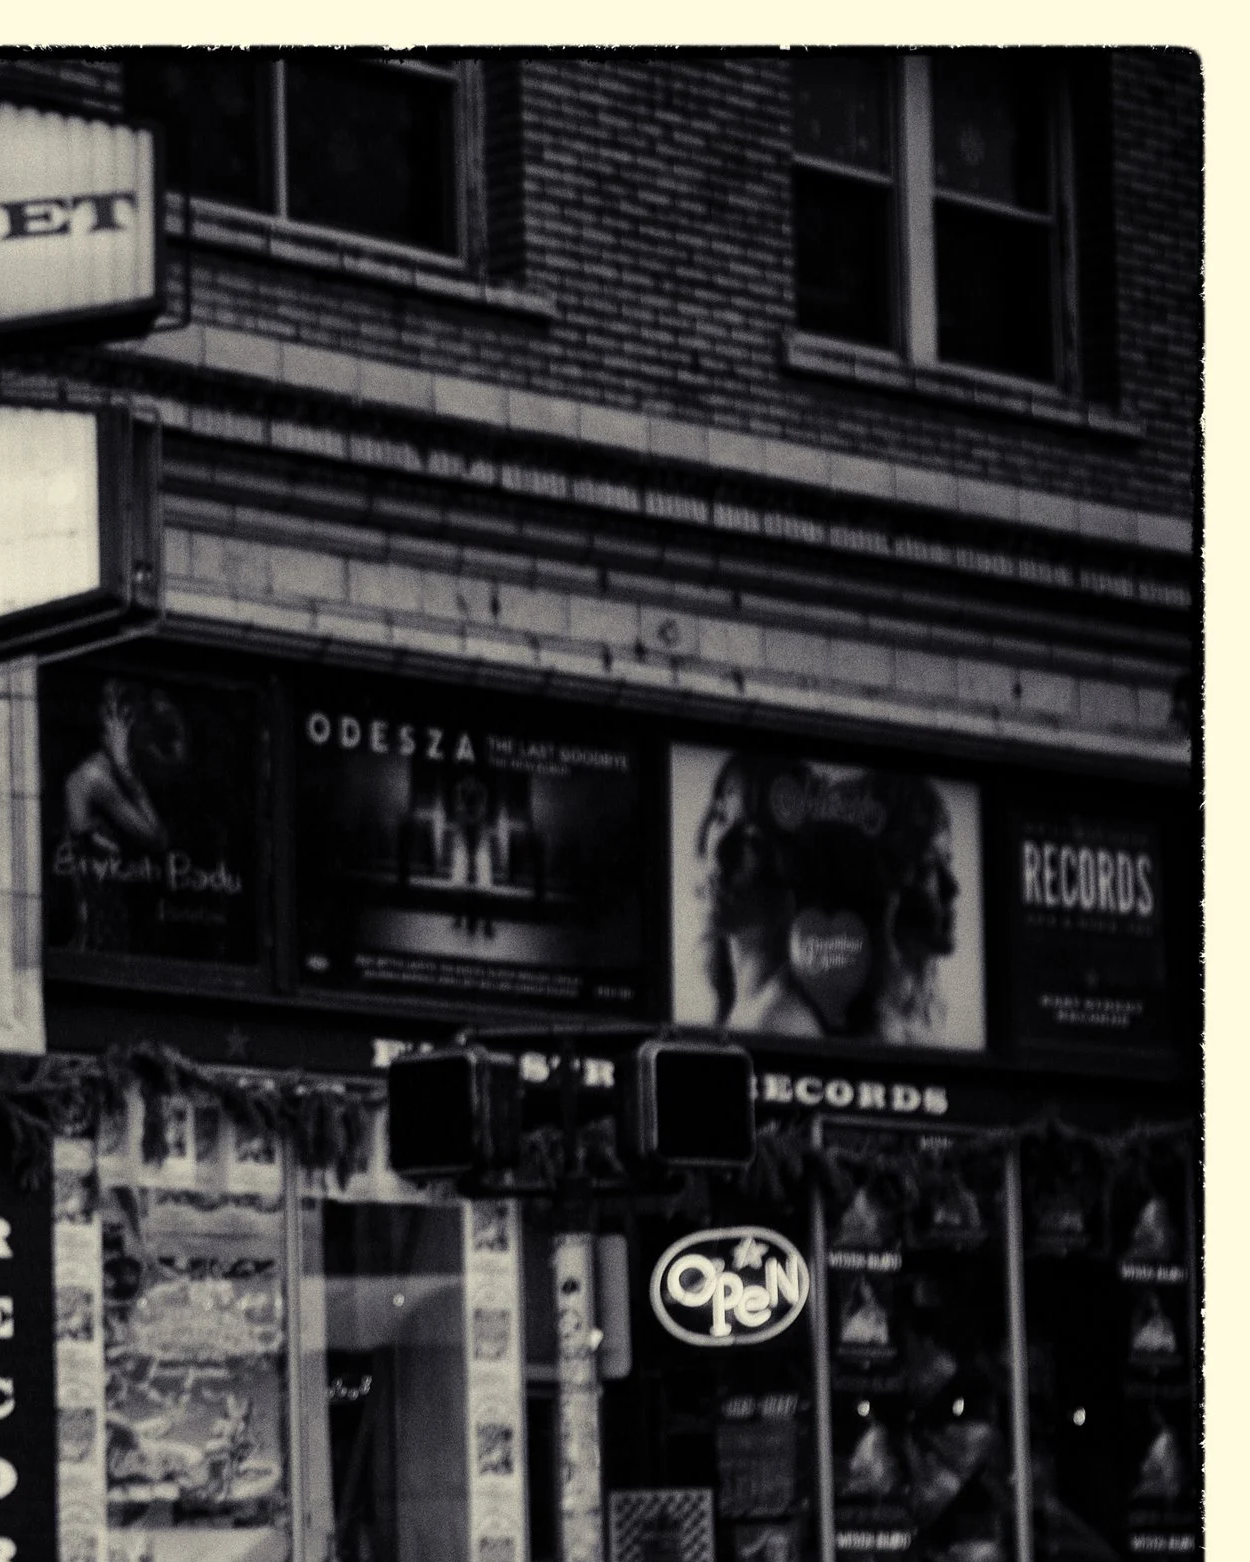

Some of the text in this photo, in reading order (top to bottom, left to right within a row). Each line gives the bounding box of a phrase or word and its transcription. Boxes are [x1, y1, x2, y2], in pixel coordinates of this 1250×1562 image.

[304, 709, 476, 765] ODESZA
[1020, 839, 1154, 918] RECORDS
[750, 1072, 948, 1116] ECORDS
